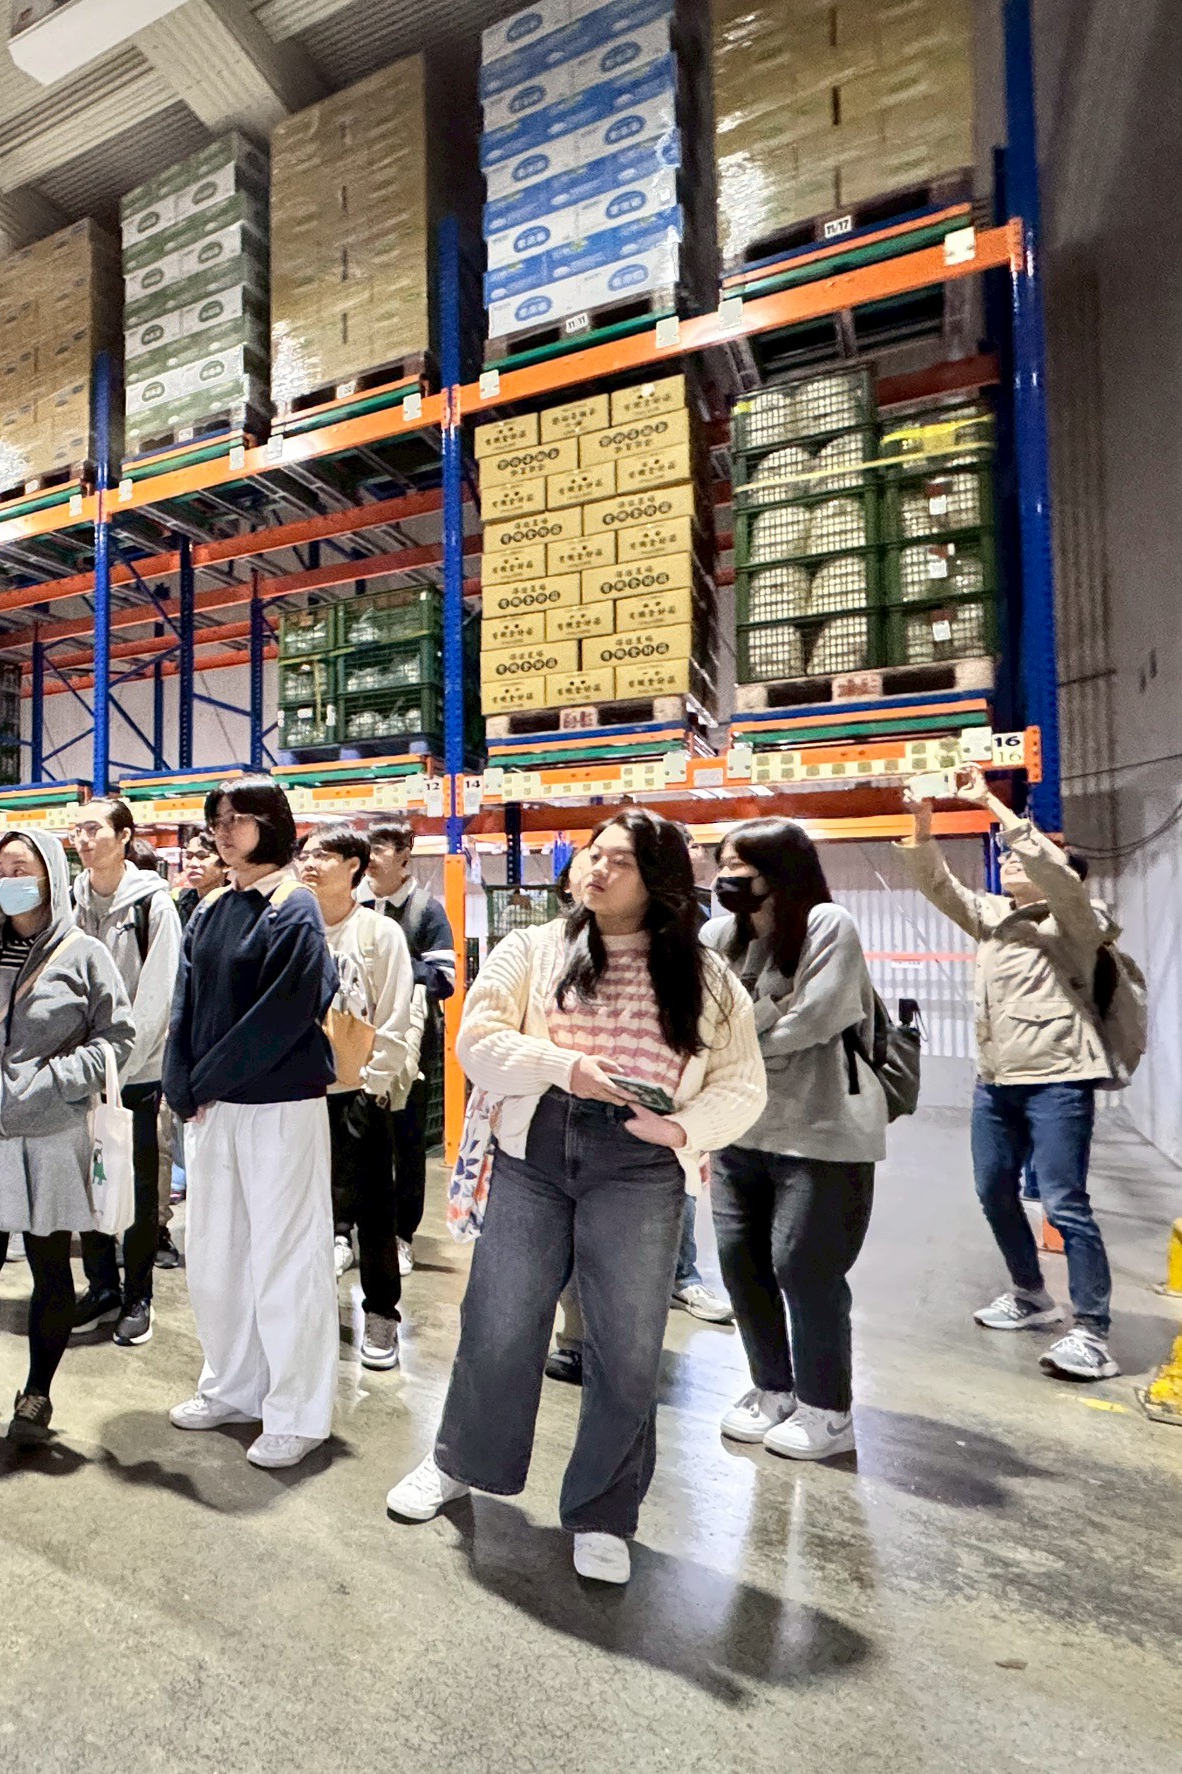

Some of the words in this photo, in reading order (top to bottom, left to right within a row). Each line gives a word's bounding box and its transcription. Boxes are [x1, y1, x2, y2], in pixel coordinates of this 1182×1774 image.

[993, 735, 1022, 748] 16
[998, 750, 1022, 763] 16
[425, 781, 440, 791] 12
[465, 779, 481, 788] 14
